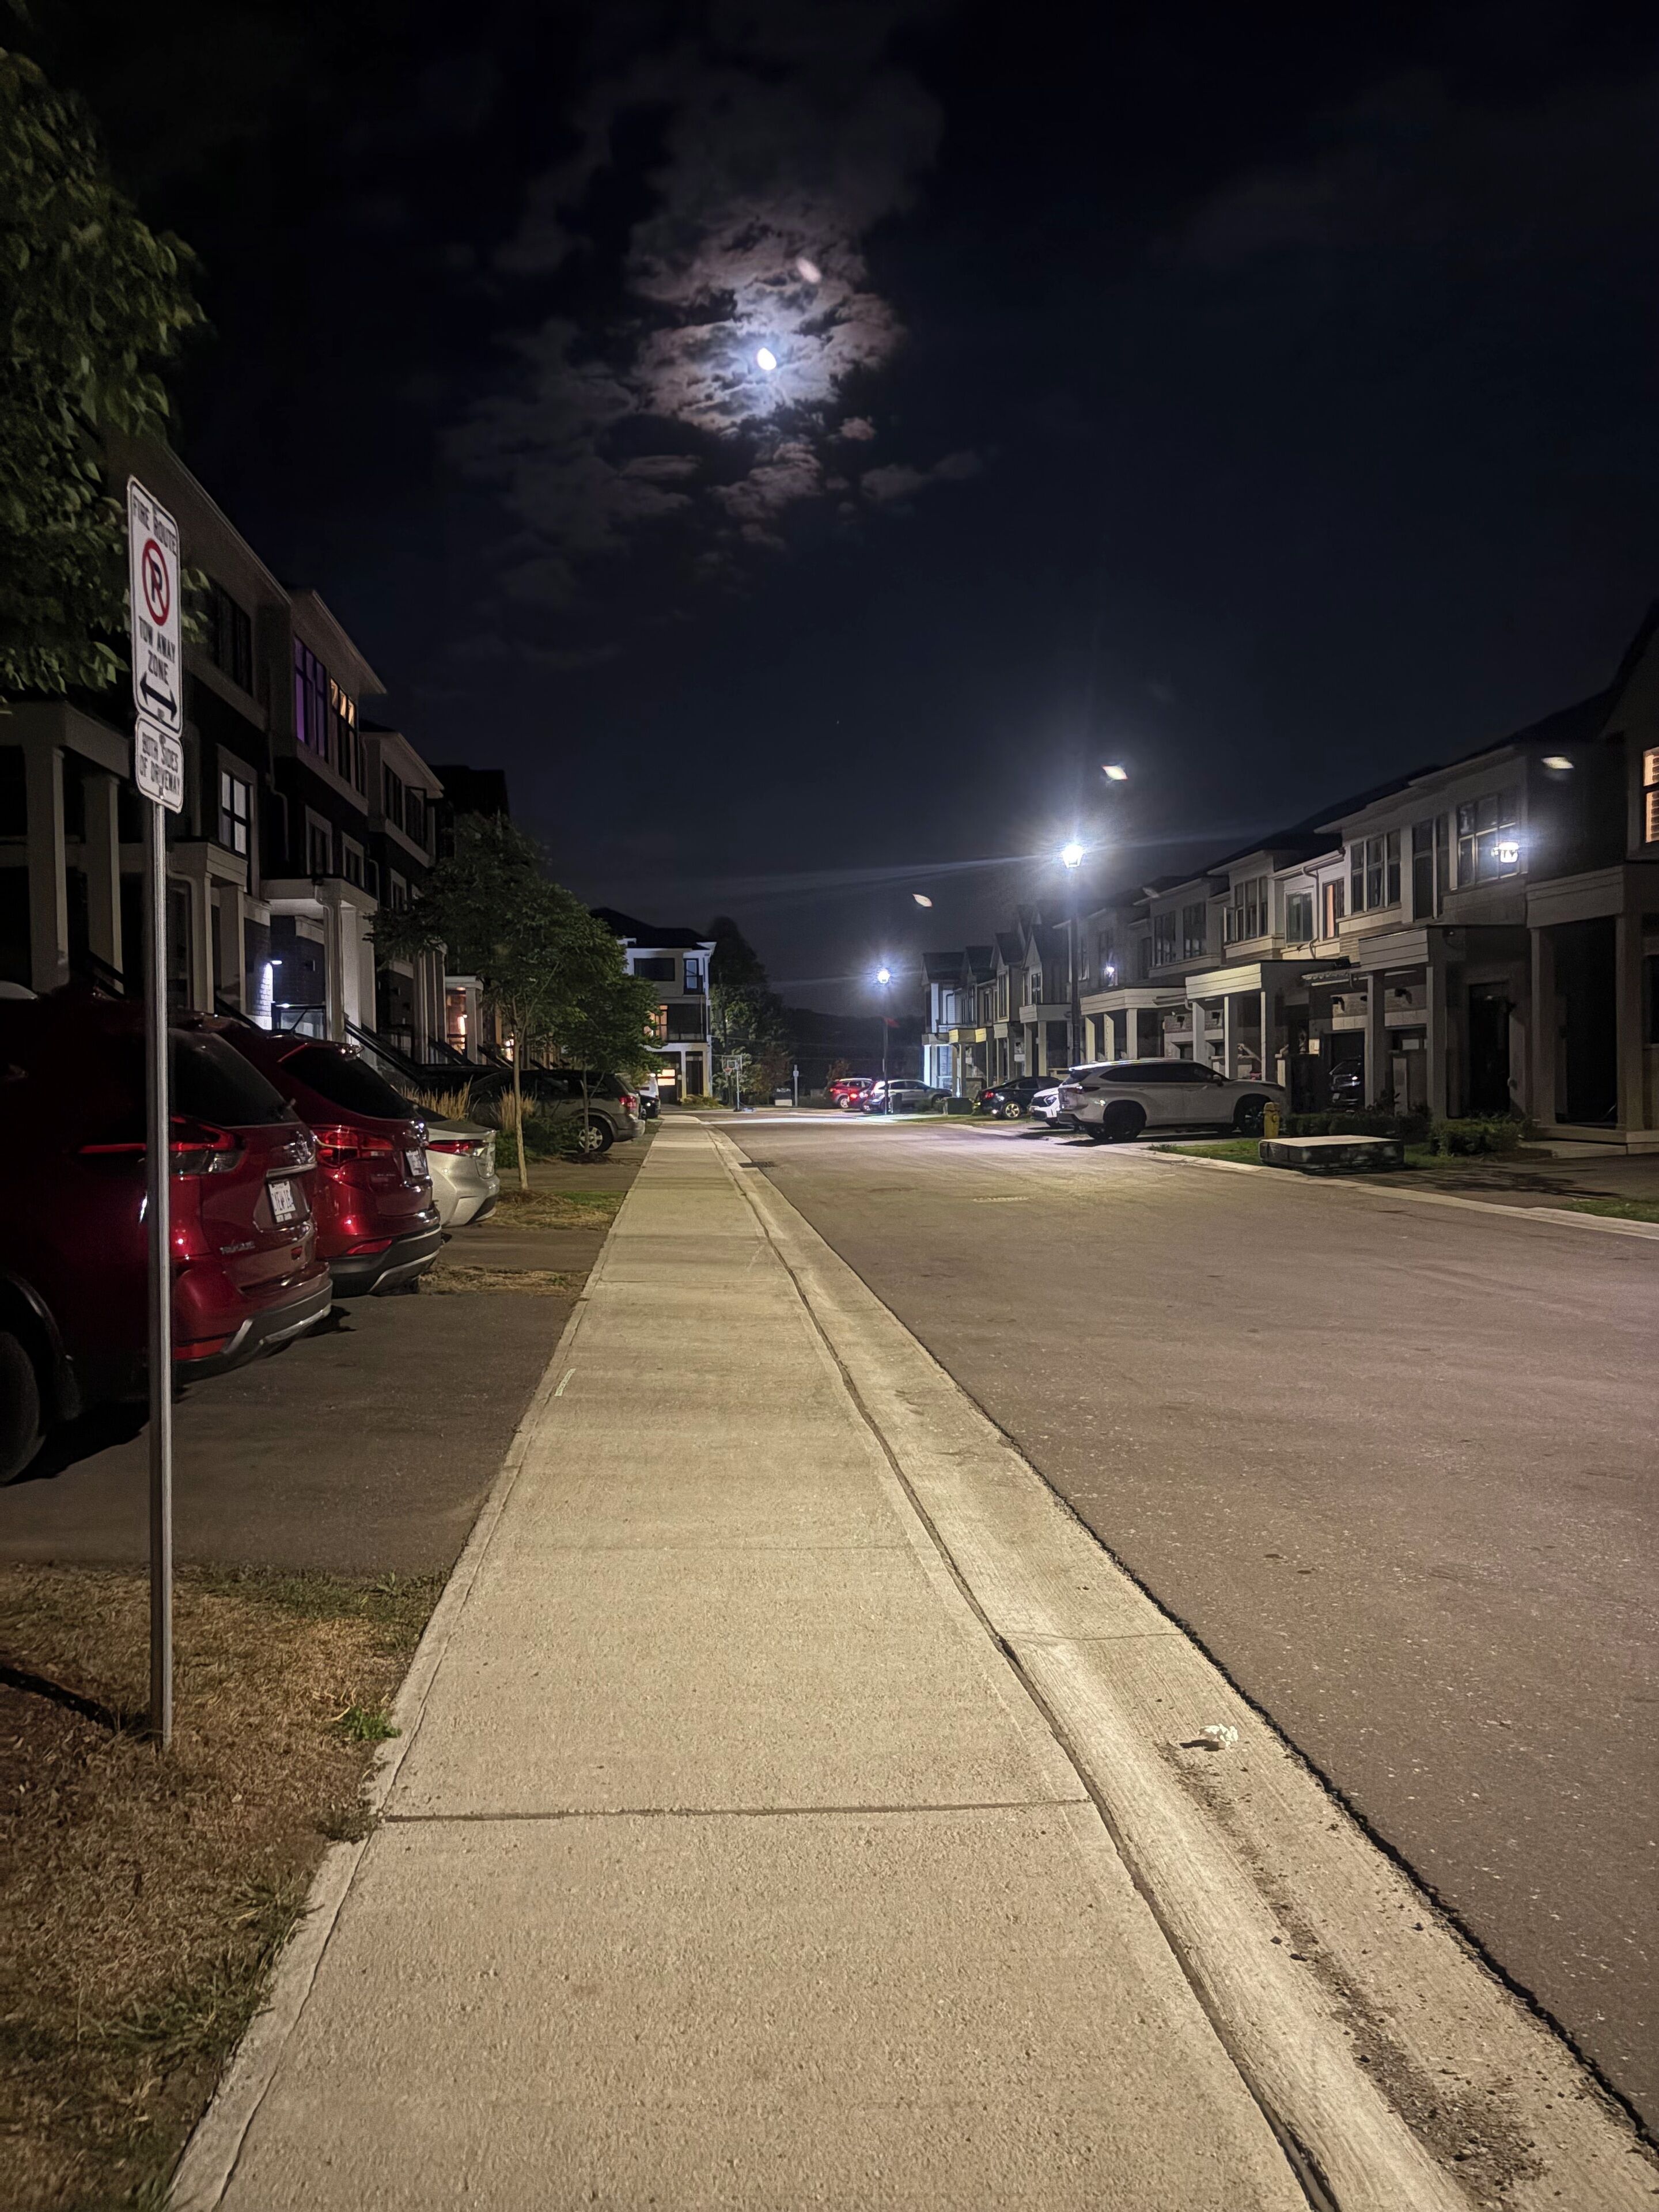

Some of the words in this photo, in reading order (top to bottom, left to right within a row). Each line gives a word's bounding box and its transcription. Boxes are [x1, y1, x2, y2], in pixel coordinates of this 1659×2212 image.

[138, 616, 153, 646] TOW
[157, 631, 175, 662] AWAY
[148, 650, 169, 685] ZONE
